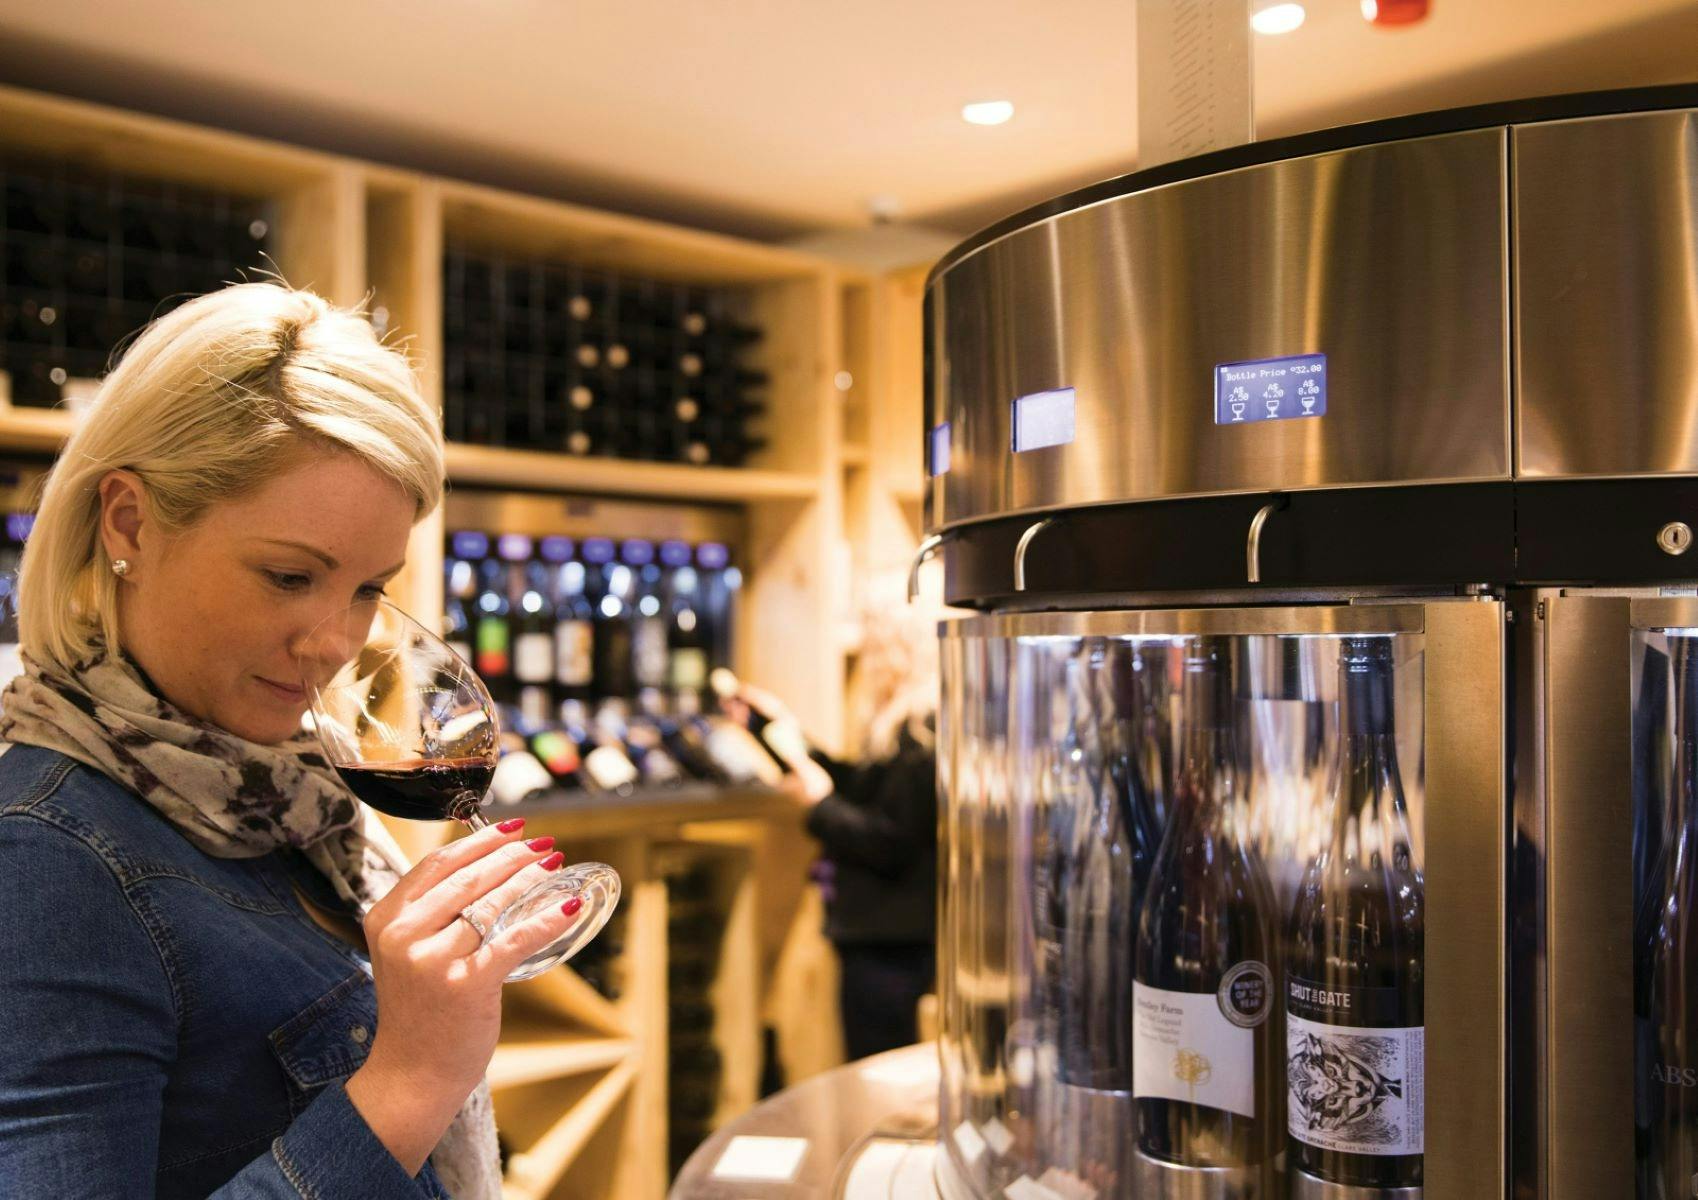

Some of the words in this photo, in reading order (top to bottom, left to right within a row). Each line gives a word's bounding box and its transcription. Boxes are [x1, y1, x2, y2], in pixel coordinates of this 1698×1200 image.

[1226, 371, 1256, 381] Bottle
[1290, 982, 1311, 1001] SHUT
[1319, 990, 1351, 1008] GATE
[1161, 1002, 1184, 1016] Farm
